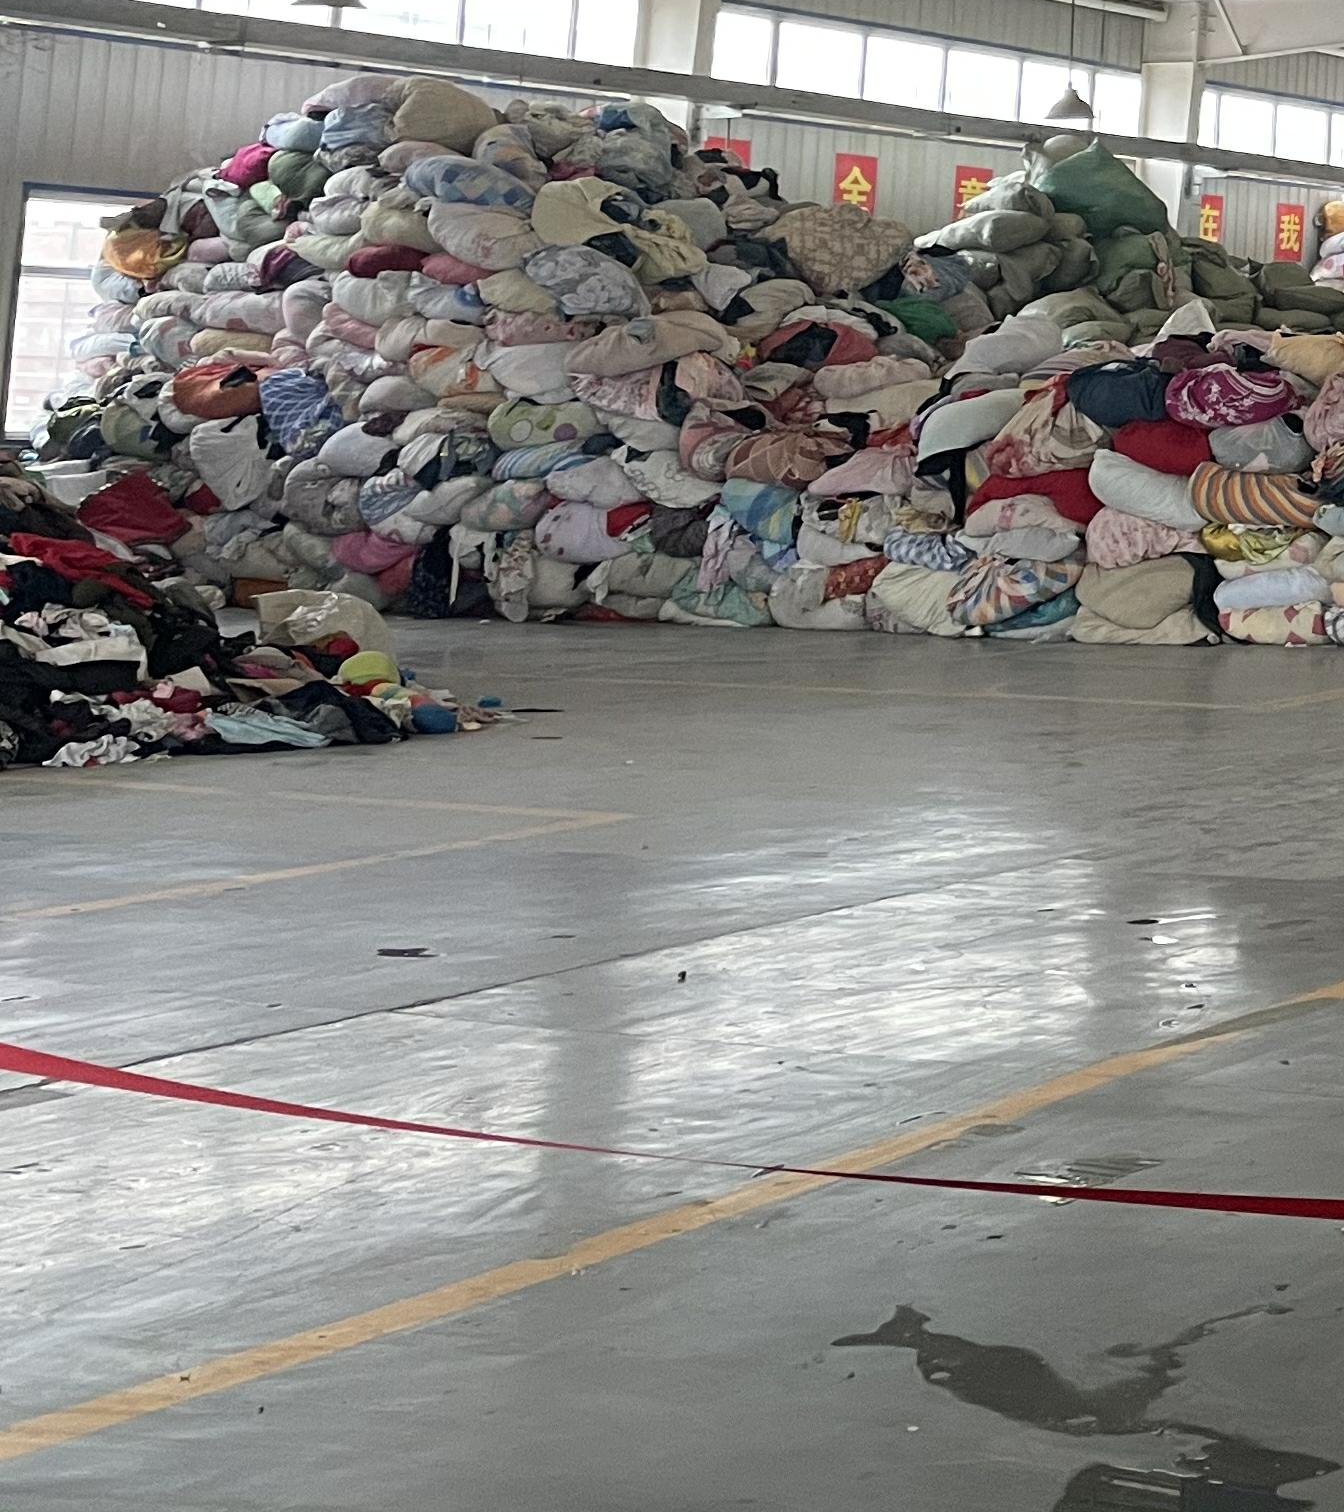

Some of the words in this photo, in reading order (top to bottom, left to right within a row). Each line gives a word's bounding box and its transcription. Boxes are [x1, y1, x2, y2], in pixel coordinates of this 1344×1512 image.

[838, 165, 872, 205] 全
[1200, 204, 1221, 243] 在
[1279, 213, 1301, 253] 我
